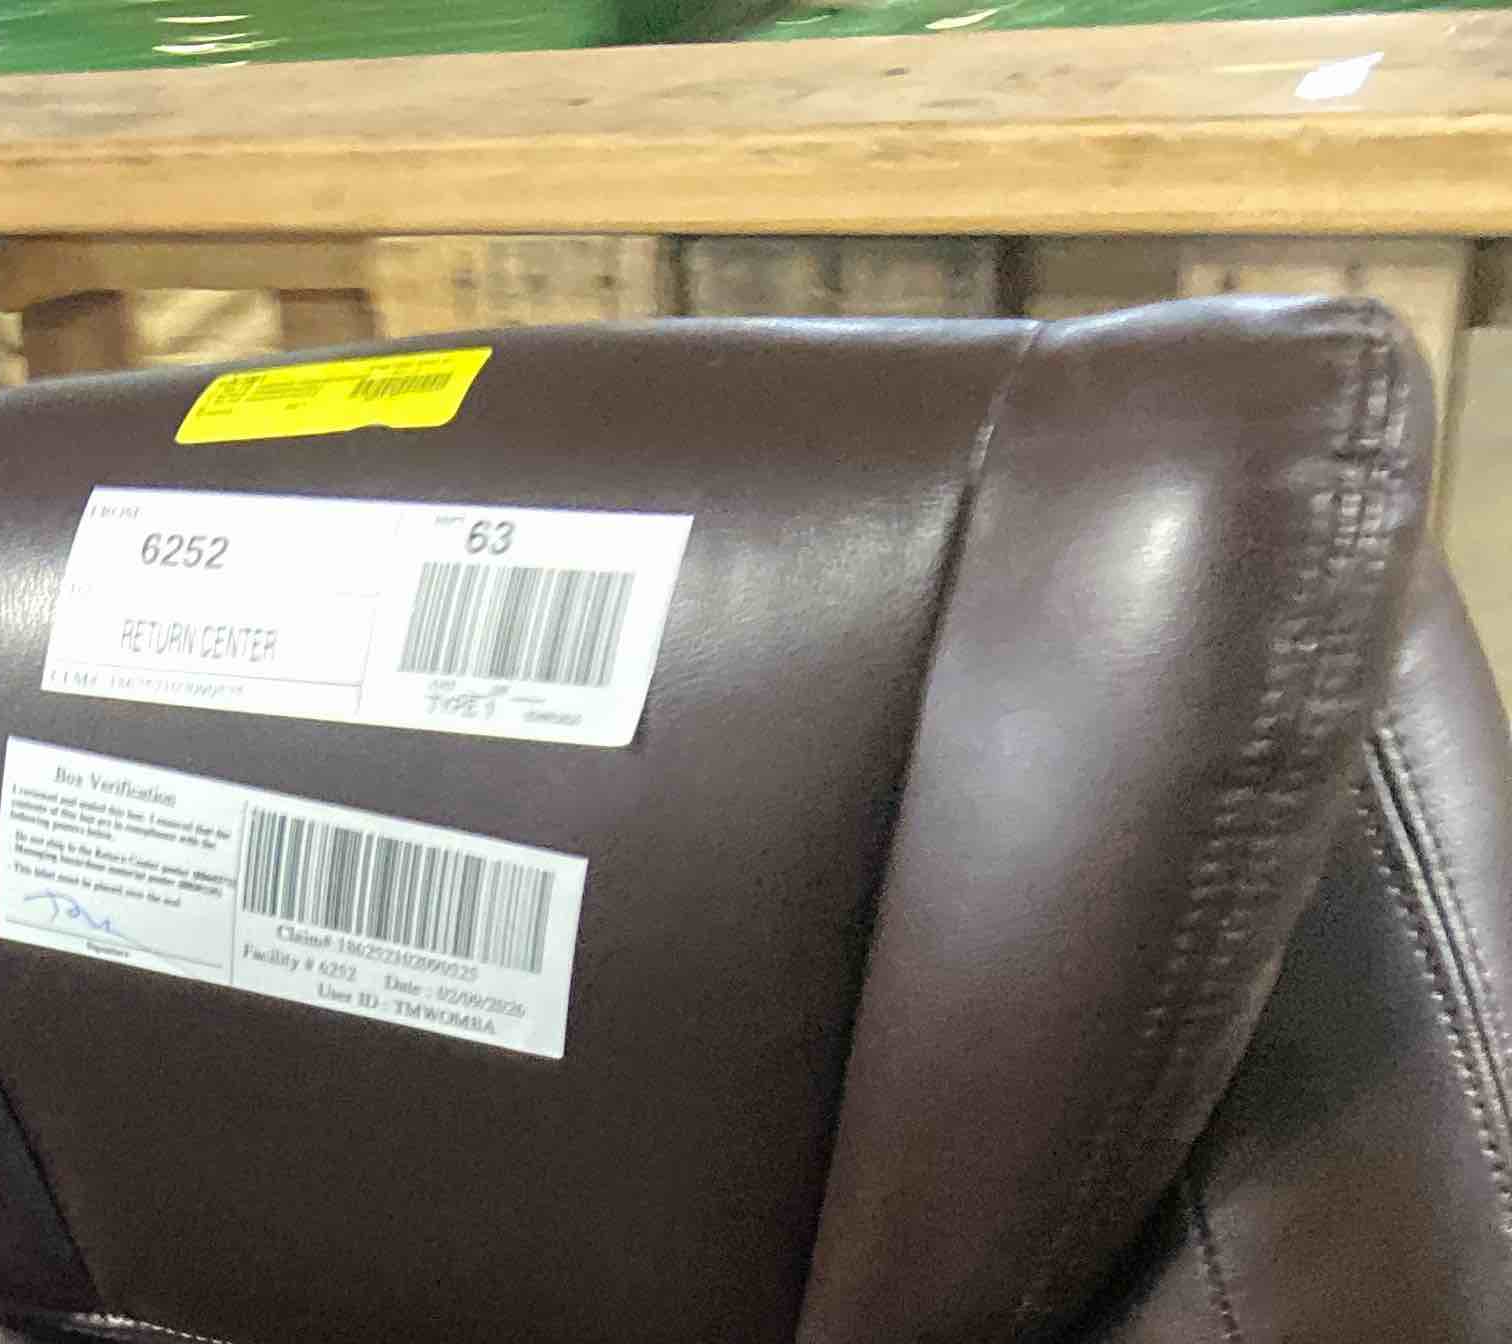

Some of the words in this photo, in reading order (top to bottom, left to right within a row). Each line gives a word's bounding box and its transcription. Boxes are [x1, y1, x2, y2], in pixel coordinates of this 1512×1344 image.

[141, 532, 230, 570] 6252
[465, 519, 515, 556] 63
[120, 618, 197, 656] RETURN
[200, 625, 278, 663] CENTER
[54, 767, 83, 788] Box
[90, 772, 176, 807] Verification
[242, 942, 300, 972] Facility
[316, 959, 358, 983] 6252
[384, 974, 422, 998] Date
[316, 982, 353, 1005] User
[356, 994, 377, 1011] ID
